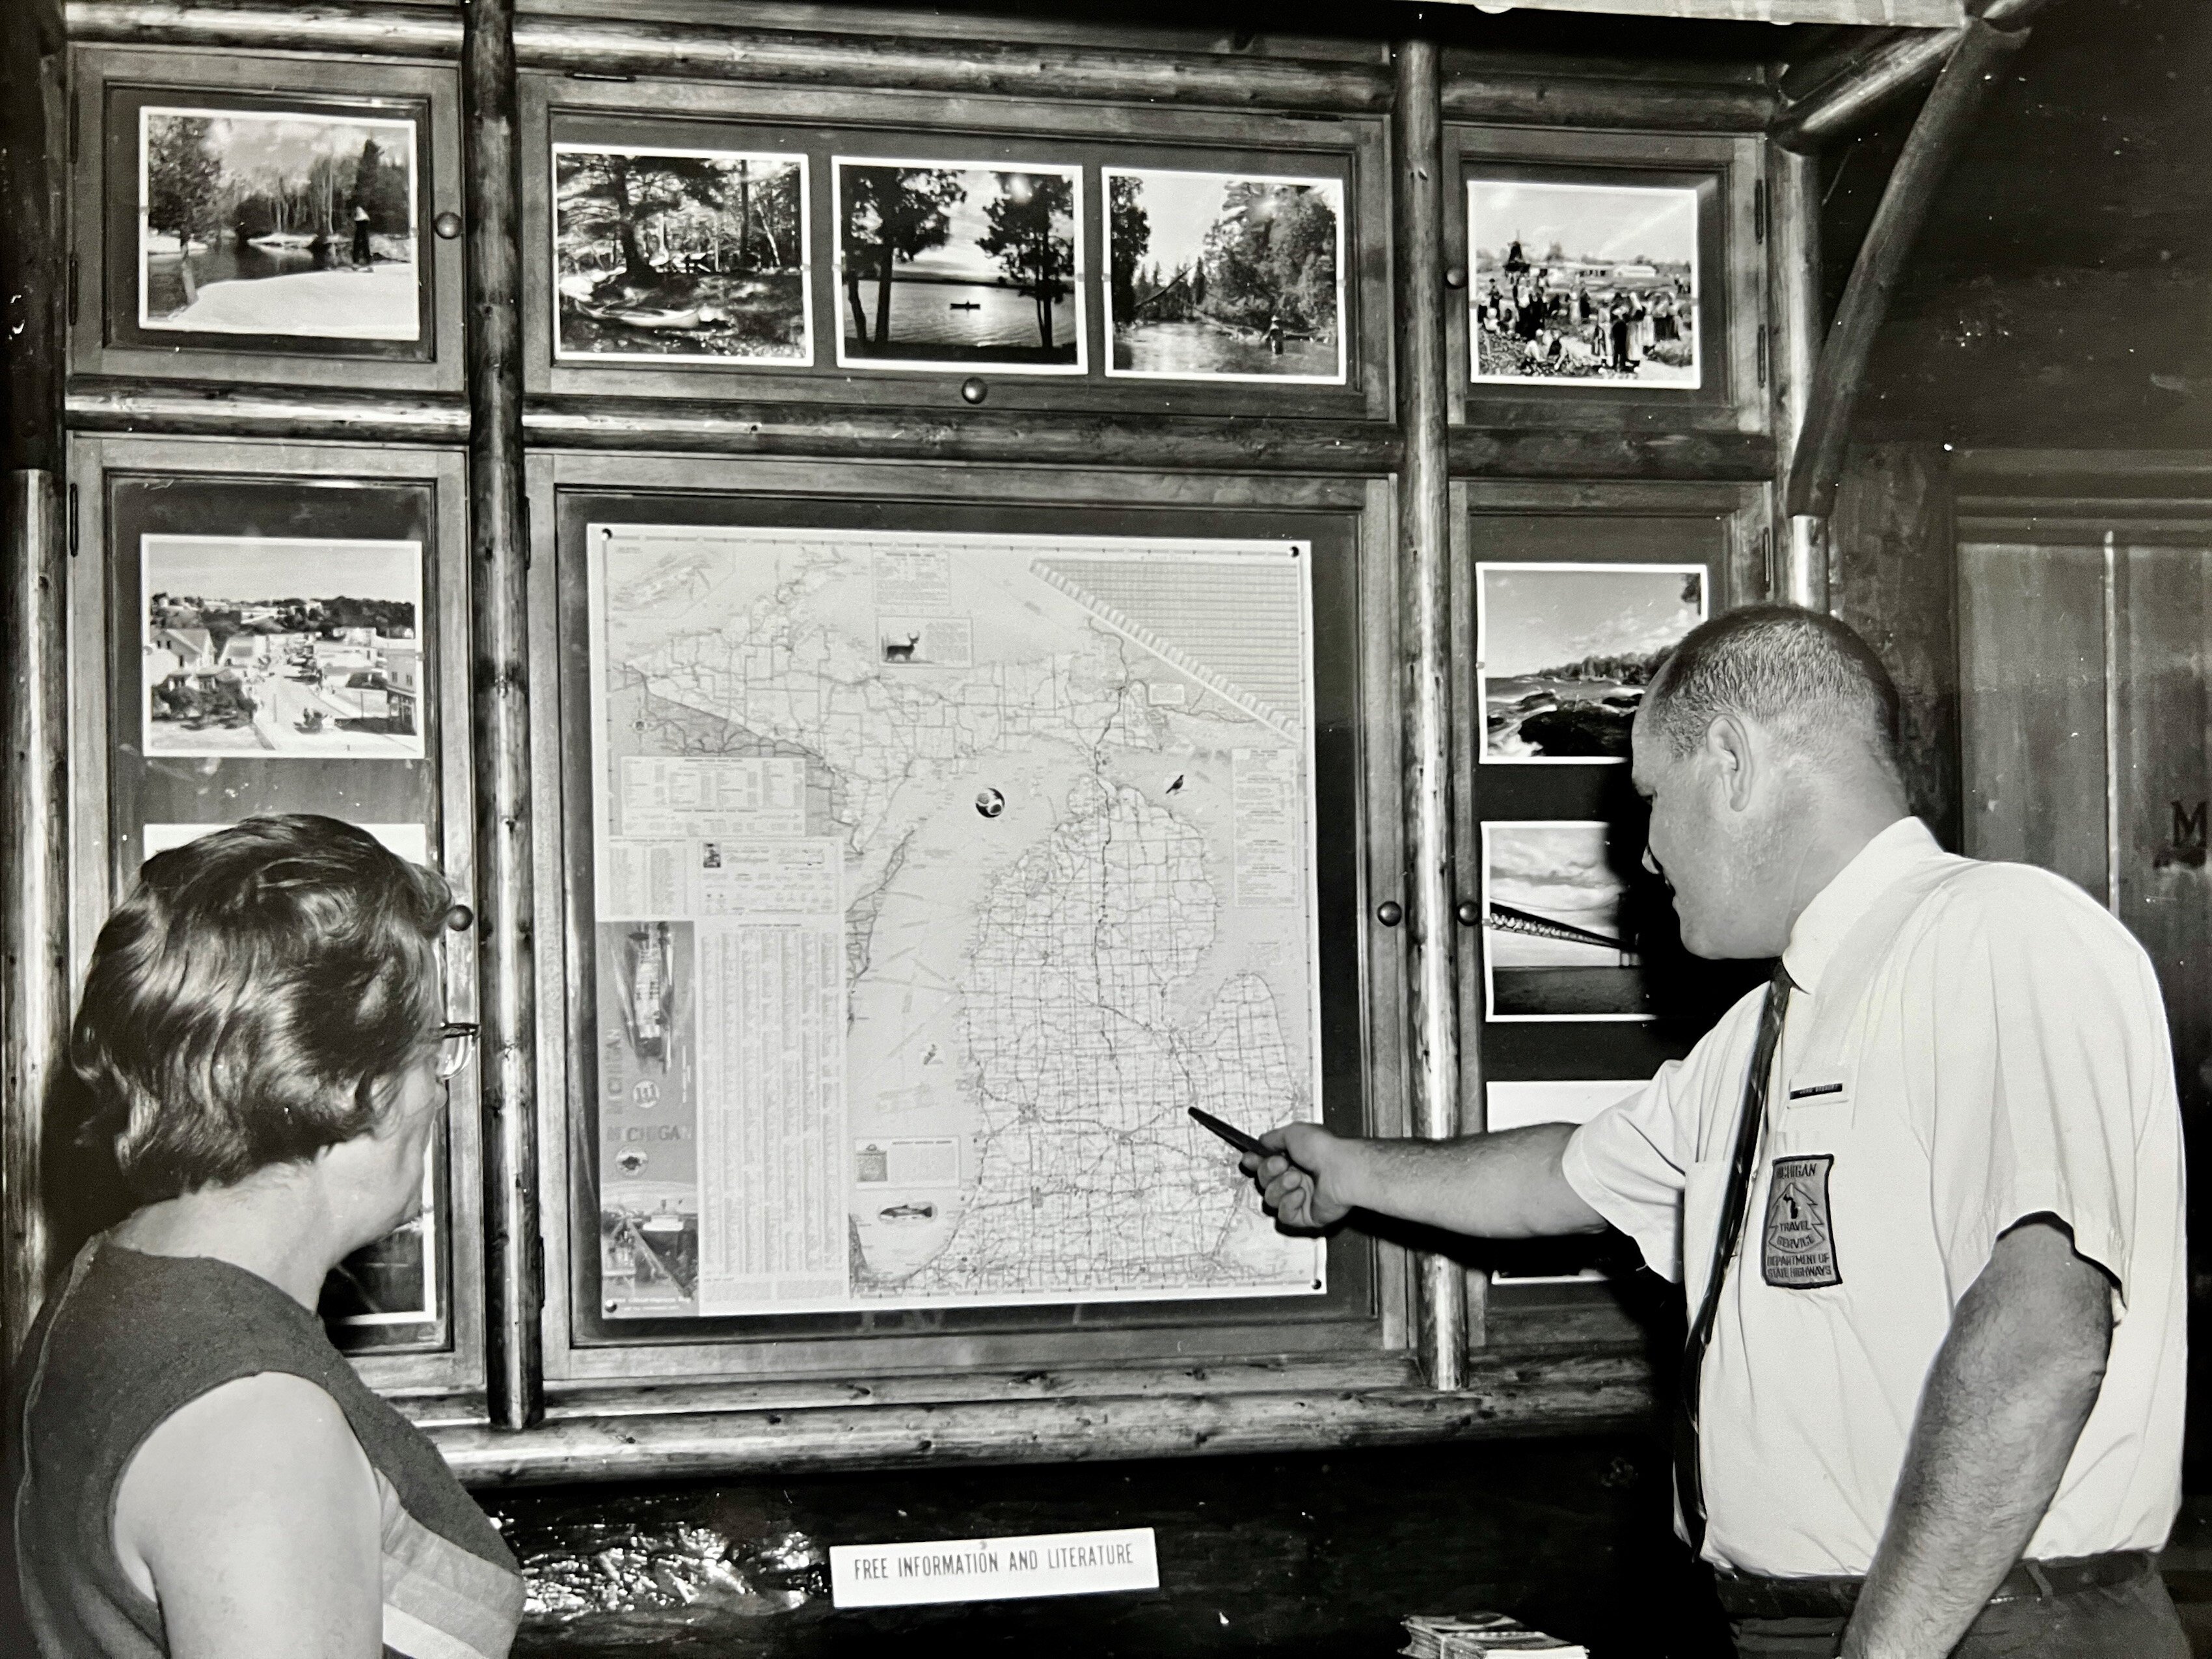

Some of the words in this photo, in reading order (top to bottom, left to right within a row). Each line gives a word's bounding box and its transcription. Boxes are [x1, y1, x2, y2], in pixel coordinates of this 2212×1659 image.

[2170, 801, 2207, 848] M
[1779, 1220, 1811, 1232] TRAVEL
[1777, 1235, 1815, 1248] SERVICE
[1767, 1254, 1816, 1267] DEPARTMENT
[1818, 1252, 1830, 1264] OF
[1768, 1267, 1788, 1279] STATE
[1790, 1265, 1832, 1277] HIGHWAYS
[854, 1558, 888, 1580] FREE
[898, 1552, 999, 1577] INFORMATION
[1010, 1550, 1038, 1571] AND
[1048, 1543, 1134, 1569] LITERATURE
